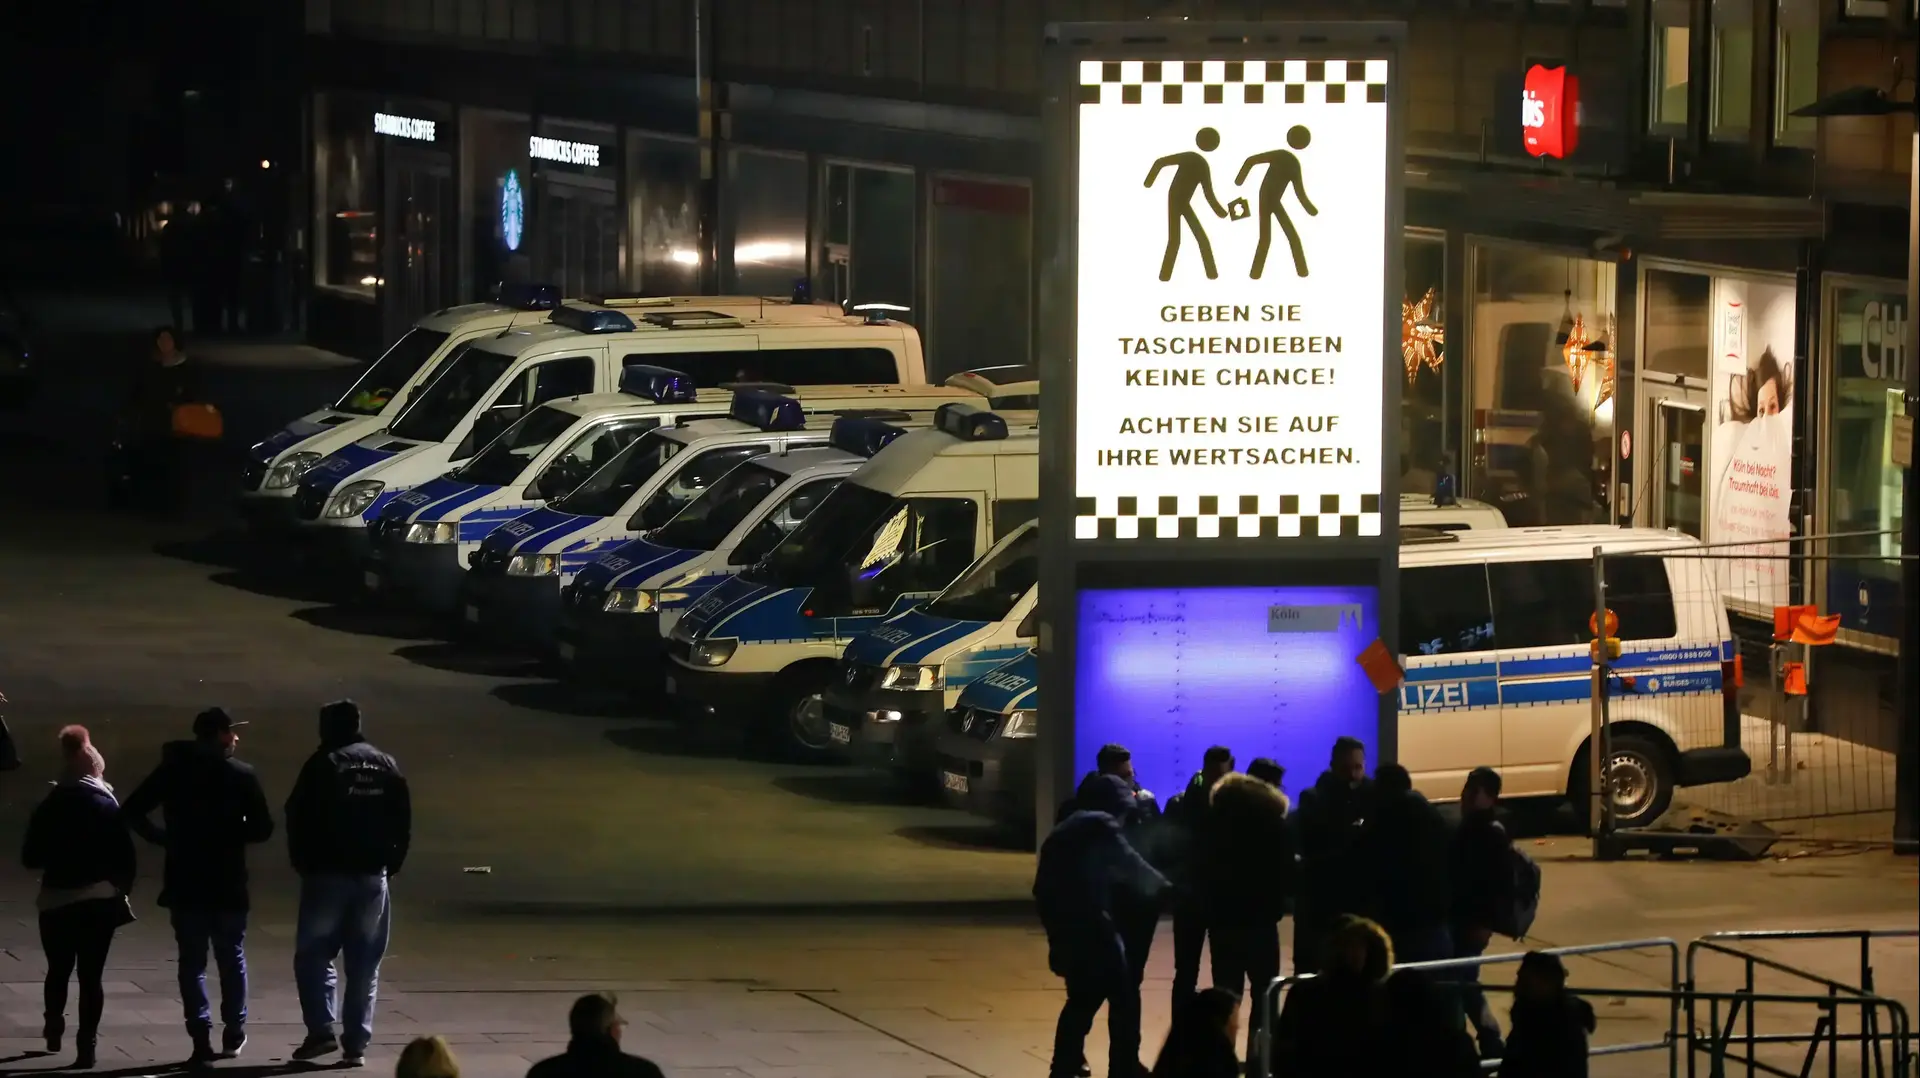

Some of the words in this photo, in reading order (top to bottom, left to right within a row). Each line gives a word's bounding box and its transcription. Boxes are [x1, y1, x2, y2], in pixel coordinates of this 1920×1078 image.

[374, 112, 411, 139] STARBUCKS
[411, 118, 436, 142] COFFEE
[529, 136, 571, 163] STARBUCKS
[571, 142, 600, 167] COFFEE
[1160, 304, 1250, 322] GEBEN
[1260, 304, 1301, 322] SIE
[1118, 336, 1342, 355] TASCHENDIEBEN
[1125, 369, 1206, 386] KEINE
[1216, 368, 1335, 386] CHANCE!
[1119, 416, 1227, 434] ACHTEN
[1237, 416, 1279, 433] SIE
[1289, 415, 1340, 433] AUF
[1098, 449, 1159, 466] IHRE
[1169, 447, 1361, 466] WERTSACHEN.
[1756, 463, 1776, 479] Nacht?
[1729, 477, 1759, 496] Traumhaft
[502, 519, 535, 537] POLIZEI
[870, 624, 912, 645] POLIZEI
[983, 670, 1031, 692] POLIZEI
[1400, 681, 1469, 710] LIZEI
